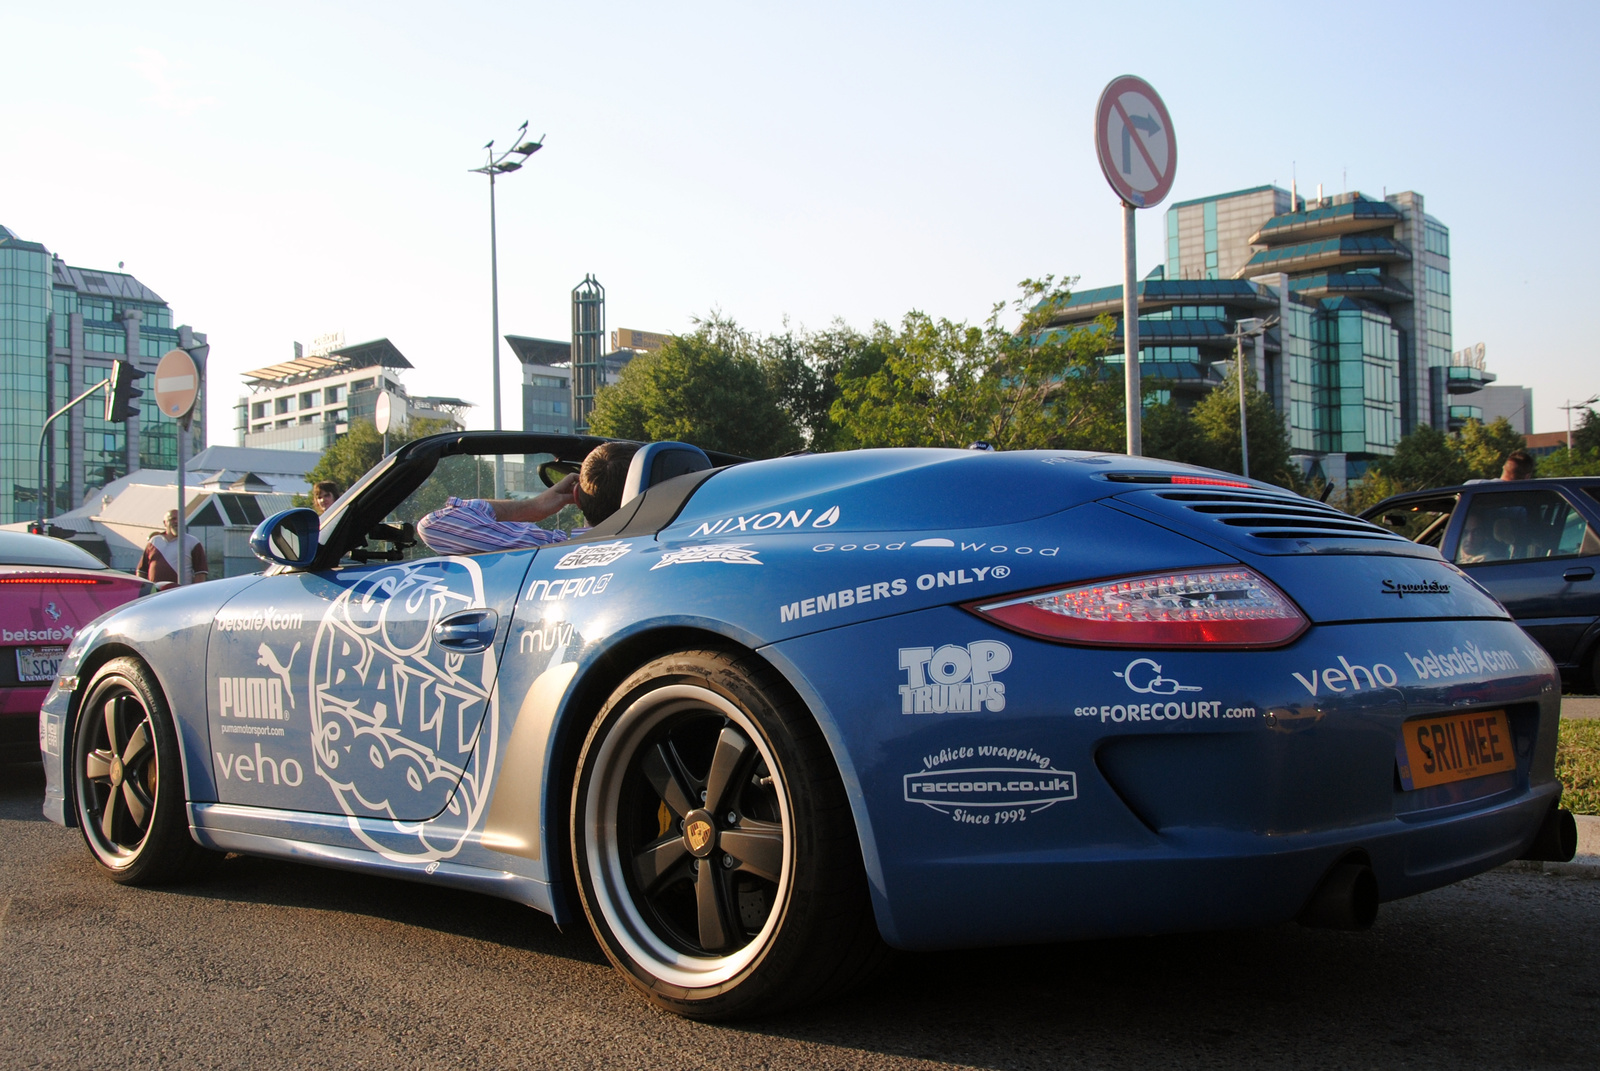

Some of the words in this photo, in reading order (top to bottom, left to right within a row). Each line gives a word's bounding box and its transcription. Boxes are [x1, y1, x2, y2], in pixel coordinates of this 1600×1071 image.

[688, 509, 813, 537] NIXON
[525, 576, 597, 600] INCIPIO
[780, 579, 908, 623] MEMBERS
[899, 640, 1013, 690] TOP
[1291, 655, 1398, 697] veho
[899, 681, 1006, 715] TRUMPS
[221, 725, 285, 737] pumamotorsport.com
[1461, 717, 1504, 767] MEE
[216, 742, 304, 787] veho
[923, 747, 974, 769] Vehicle
[911, 778, 1070, 793] raccoon.co.uk
[952, 808, 990, 824] Since
[994, 808, 1027, 824] 1992
